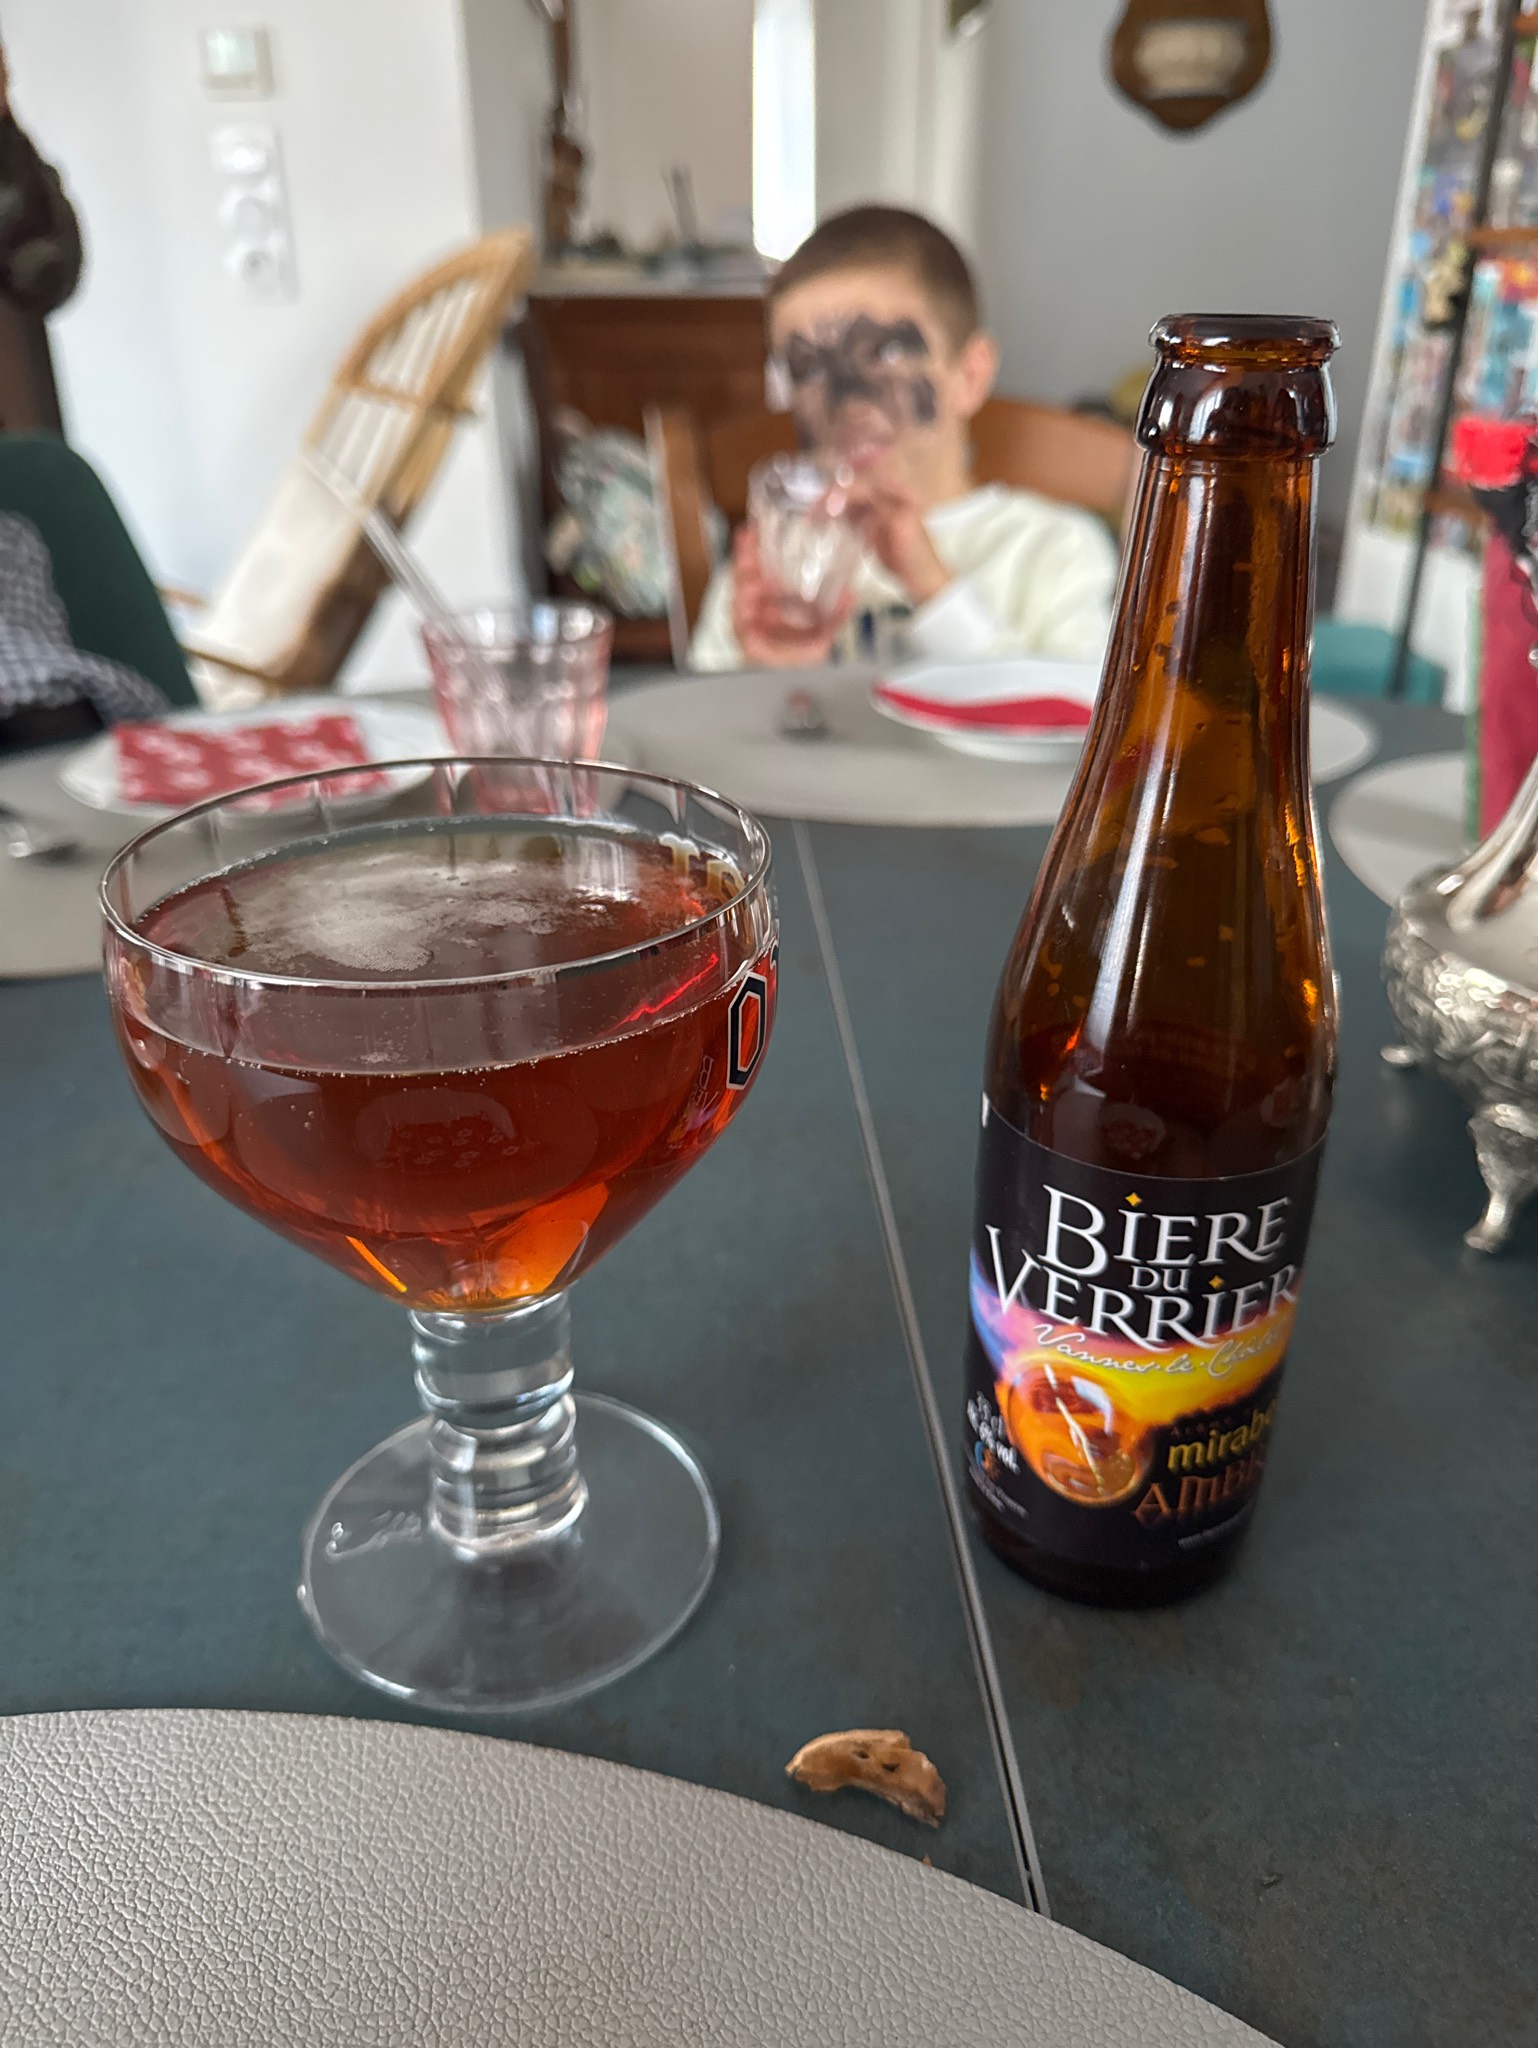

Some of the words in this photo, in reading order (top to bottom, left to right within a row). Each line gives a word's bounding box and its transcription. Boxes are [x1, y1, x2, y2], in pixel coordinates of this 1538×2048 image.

[1037, 1184, 1293, 1277] BIERE
[985, 1224, 1298, 1352] VERRIER
[1128, 1266, 1191, 1292] DU
